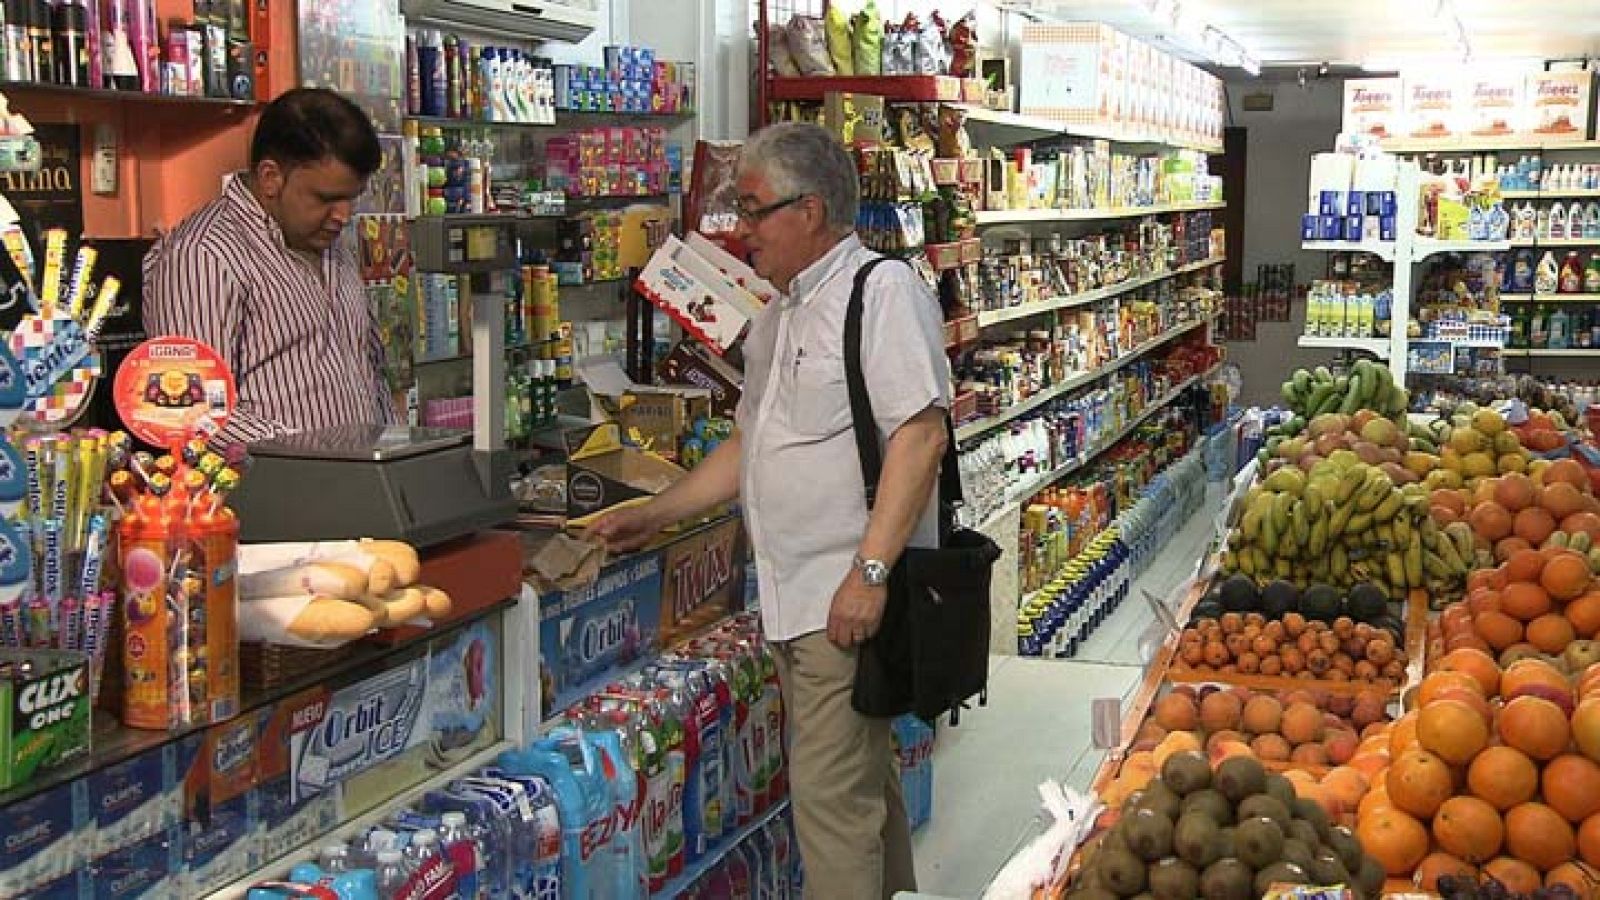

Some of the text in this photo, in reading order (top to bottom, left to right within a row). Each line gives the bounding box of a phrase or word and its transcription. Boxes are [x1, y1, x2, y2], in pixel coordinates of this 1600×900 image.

[45, 530, 58, 593] mentos
[324, 695, 385, 747] Orbit
[367, 716, 404, 760] ICE
